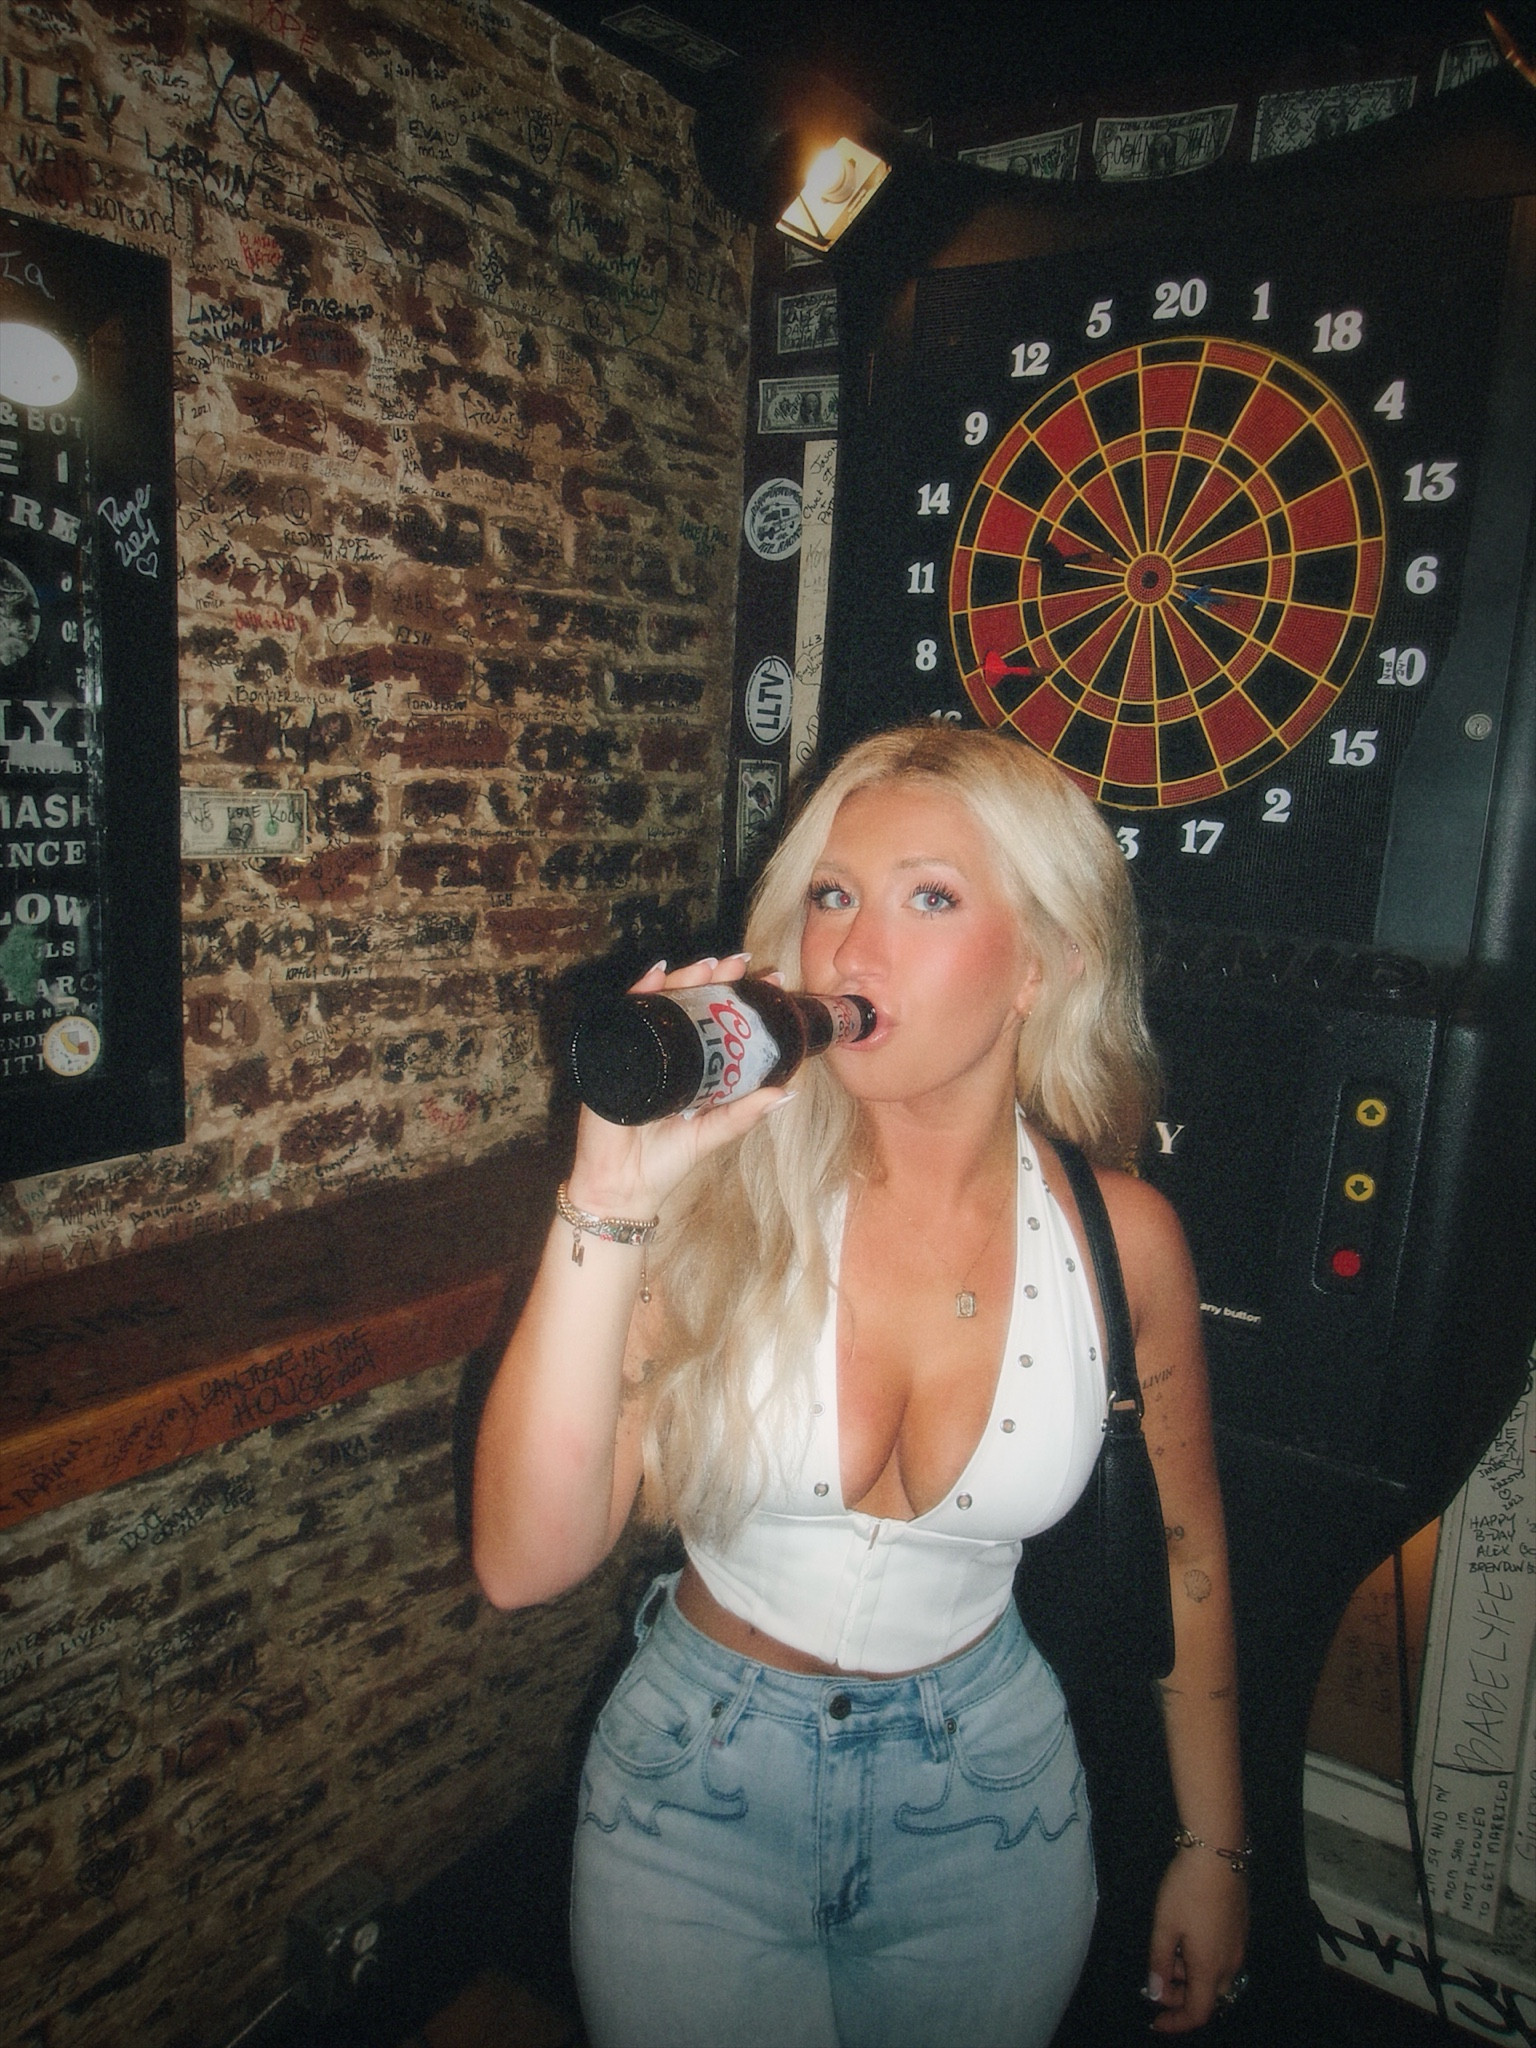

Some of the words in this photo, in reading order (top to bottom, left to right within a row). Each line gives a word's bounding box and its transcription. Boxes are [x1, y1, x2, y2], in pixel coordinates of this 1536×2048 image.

[1152, 277, 1209, 320] 20
[1252, 282, 1272, 321] 1
[1086, 299, 1114, 340] 5
[1312, 311, 1363, 353] 18
[1010, 342, 1051, 378] 12
[1374, 381, 1406, 421] 4
[964, 411, 989, 447] 9
[916, 482, 951, 516] 14
[1402, 461, 1458, 503] 13
[907, 563, 936, 596] 11
[1404, 556, 1438, 596] 6
[915, 640, 938, 672] 8
[1376, 647, 1428, 688] 10
[755, 673, 784, 732] LLTV
[1328, 729, 1378, 767] 15
[185, 801, 210, 825] WE
[1263, 788, 1294, 823] 2
[0, 841, 86, 867] NCE
[1116, 825, 1141, 861] 3
[1180, 820, 1225, 857] 17
[2, 1009, 36, 1024] PER
[692, 1017, 725, 1106] LIGH
[1154, 1120, 1185, 1155] Y
[1199, 1302, 1222, 1317] any
[1222, 1306, 1262, 1325] button
[1469, 1513, 1517, 1530] HAPPY
[1473, 1527, 1517, 1543] B-DAY
[1476, 1543, 1511, 1558] ALEX
[1433, 1783, 1452, 1803] MY
[1431, 1810, 1449, 1840] AND
[1487, 1779, 1510, 1855] MARRIED
[1428, 1845, 1442, 1869] 59
[1466, 1805, 1486, 1877] ALLOWED
[1444, 1869, 1458, 1901] MOM
[1451, 1838, 1465, 1863] SAID
[1482, 1858, 1497, 1893] GET
[1462, 1877, 1475, 1913] NOT
[1478, 1896, 1491, 1918] TO
